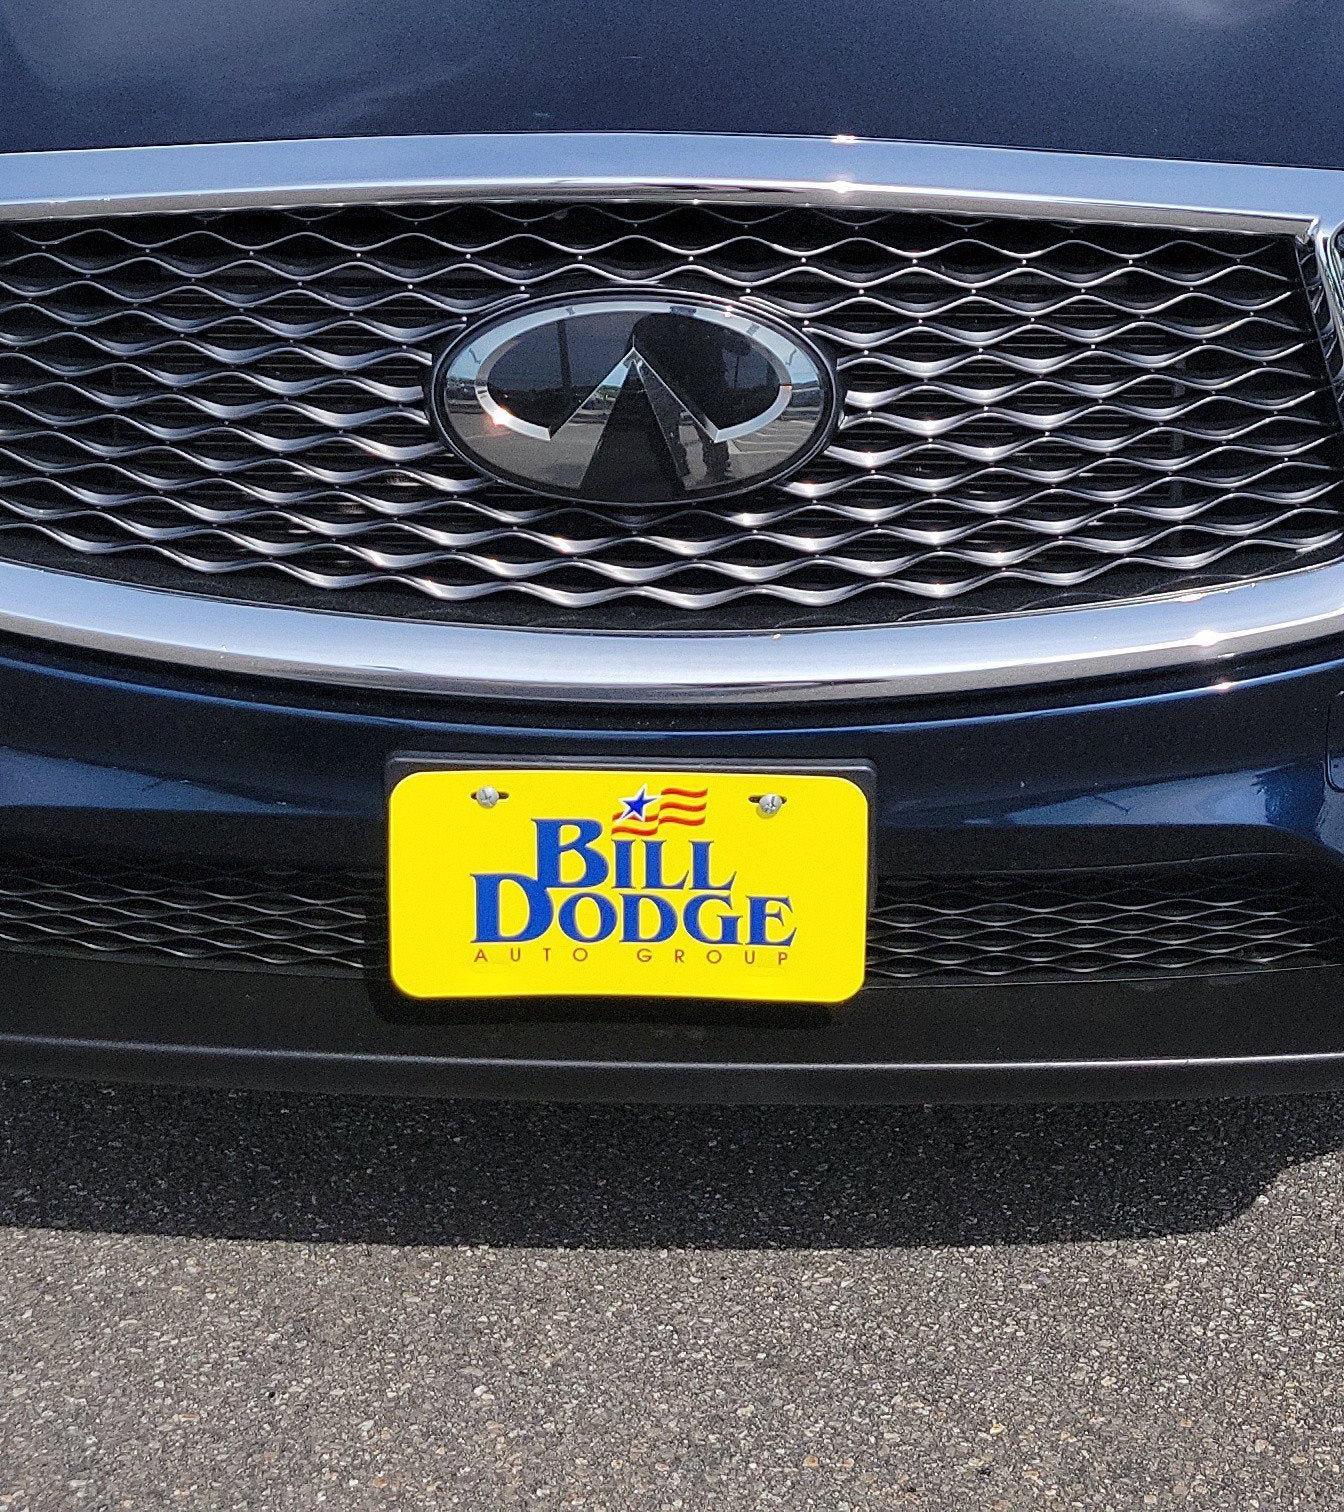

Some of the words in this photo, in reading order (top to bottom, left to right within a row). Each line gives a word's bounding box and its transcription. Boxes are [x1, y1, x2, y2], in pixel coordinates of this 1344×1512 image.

[531, 817, 738, 891] BILL
[469, 872, 798, 947] DODGE
[473, 946, 589, 964] AUTO
[635, 948, 789, 966] GROUP
